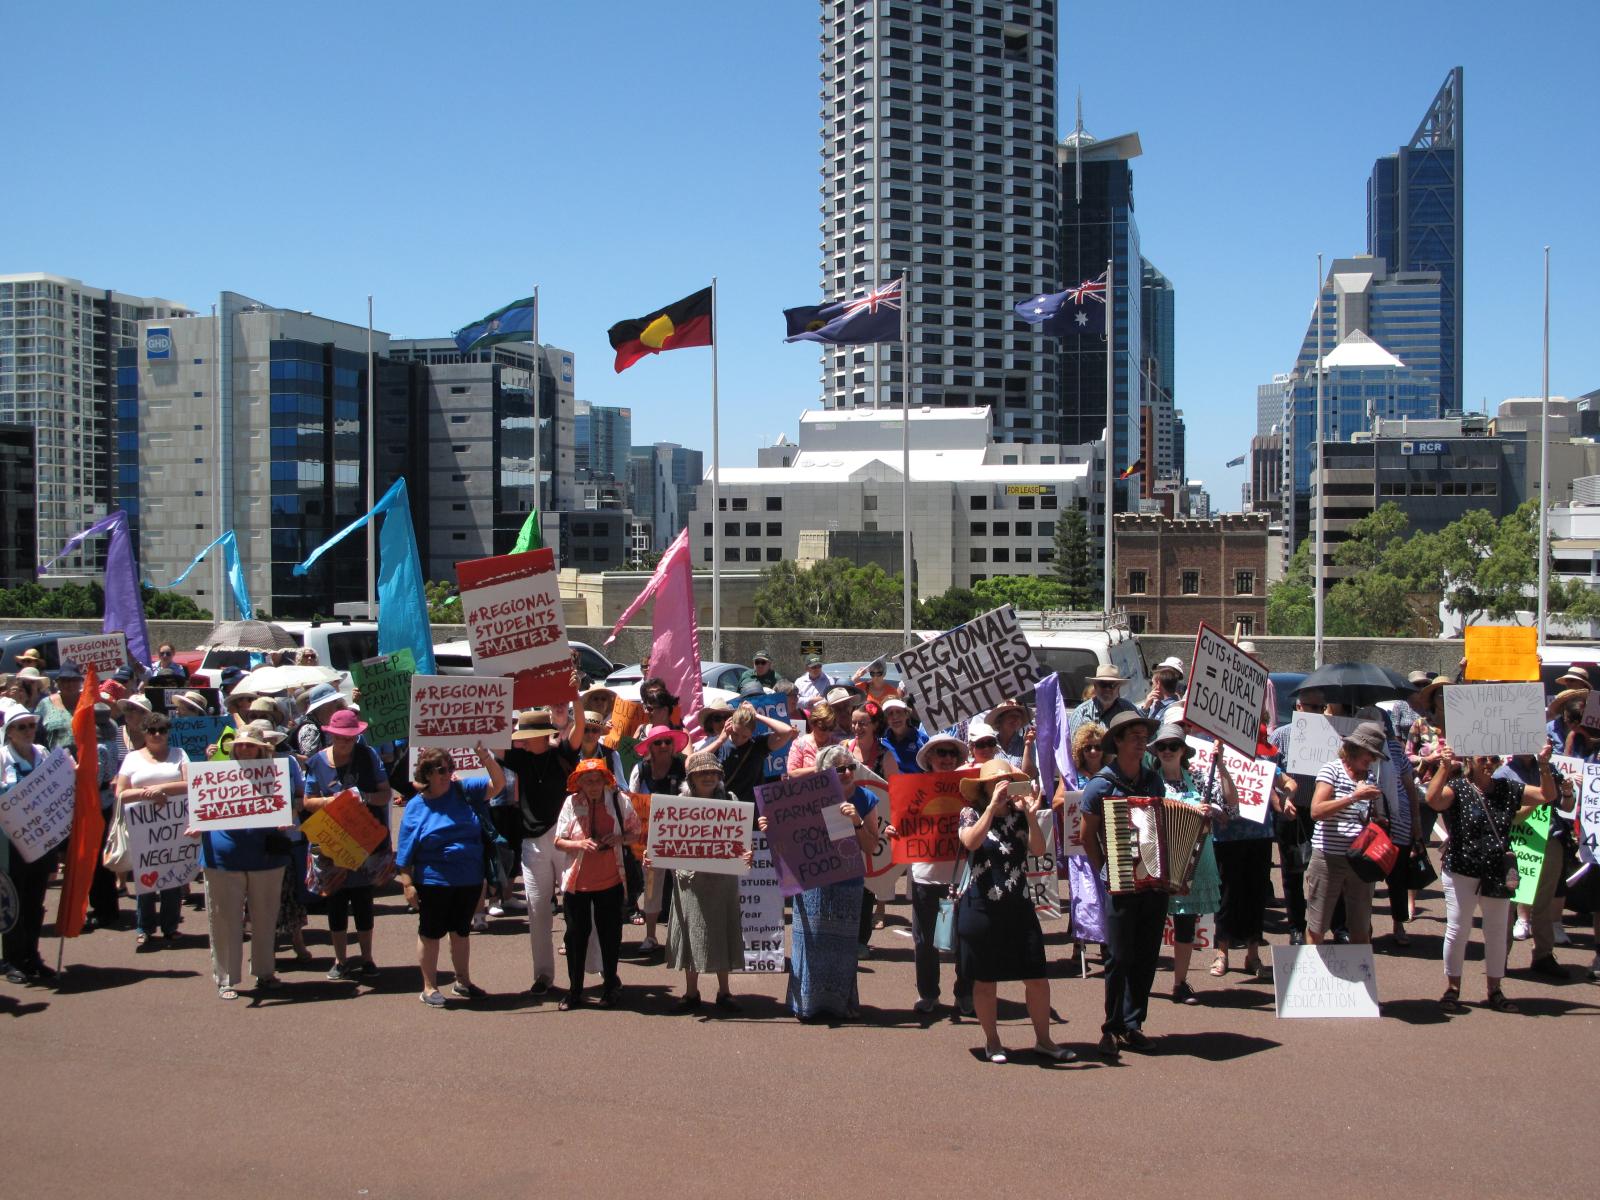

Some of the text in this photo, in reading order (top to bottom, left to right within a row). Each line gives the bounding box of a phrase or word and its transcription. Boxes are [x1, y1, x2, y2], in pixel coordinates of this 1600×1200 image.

[148, 338, 169, 349] GHD
[1419, 443, 1442, 451] RCR
[1008, 486, 1020, 495] FOR
[1021, 486, 1039, 495] LEASE
[469, 592, 555, 626] #REGIONAL
[476, 609, 556, 639] STUDENTS
[62, 638, 121, 656] #REGIONAL
[486, 627, 553, 655] MATTER
[900, 610, 1017, 679] REGIONAL
[1201, 636, 1226, 662] CUTS
[363, 655, 400, 678] KEEP
[917, 634, 1031, 704] FAMILIES
[364, 686, 412, 711] FAMILI
[415, 684, 507, 702] #REGIONAL
[925, 664, 1040, 730] MATTER
[1221, 669, 1256, 707] RURAL
[1477, 685, 1515, 702] HANDS
[419, 700, 505, 716] STUDENTS
[1193, 682, 1259, 742] ISOLATION
[370, 716, 410, 742] TOGET
[427, 718, 498, 733] MATTER
[1501, 718, 1524, 734] THE
[192, 765, 284, 789] #REGIONAL
[1, 772, 47, 811] COUNTRY
[22, 780, 60, 815] MATTER
[198, 780, 282, 801] STUDENTS
[761, 774, 830, 804] EDUCATED
[130, 799, 189, 825] NURTUR
[206, 797, 278, 817] MATTER
[653, 806, 747, 822] #REGIONAL
[12, 815, 42, 839] CAMP
[23, 799, 75, 845] HOSTELS
[657, 823, 744, 838] STUDENTS
[899, 815, 959, 837] INDIGE
[149, 823, 182, 844] NOT
[140, 843, 200, 868] NEGLECT
[665, 841, 735, 856] MATTER
[906, 838, 957, 858] EDUCA
[1518, 851, 1542, 864] ROOM
[799, 856, 841, 882] FOOD
[740, 895, 760, 904] 019
[745, 959, 776, 971] 566
[1327, 960, 1349, 973] FOR
[1298, 976, 1352, 991] COUNTRY
[1286, 992, 1357, 1008] EDUCATION
